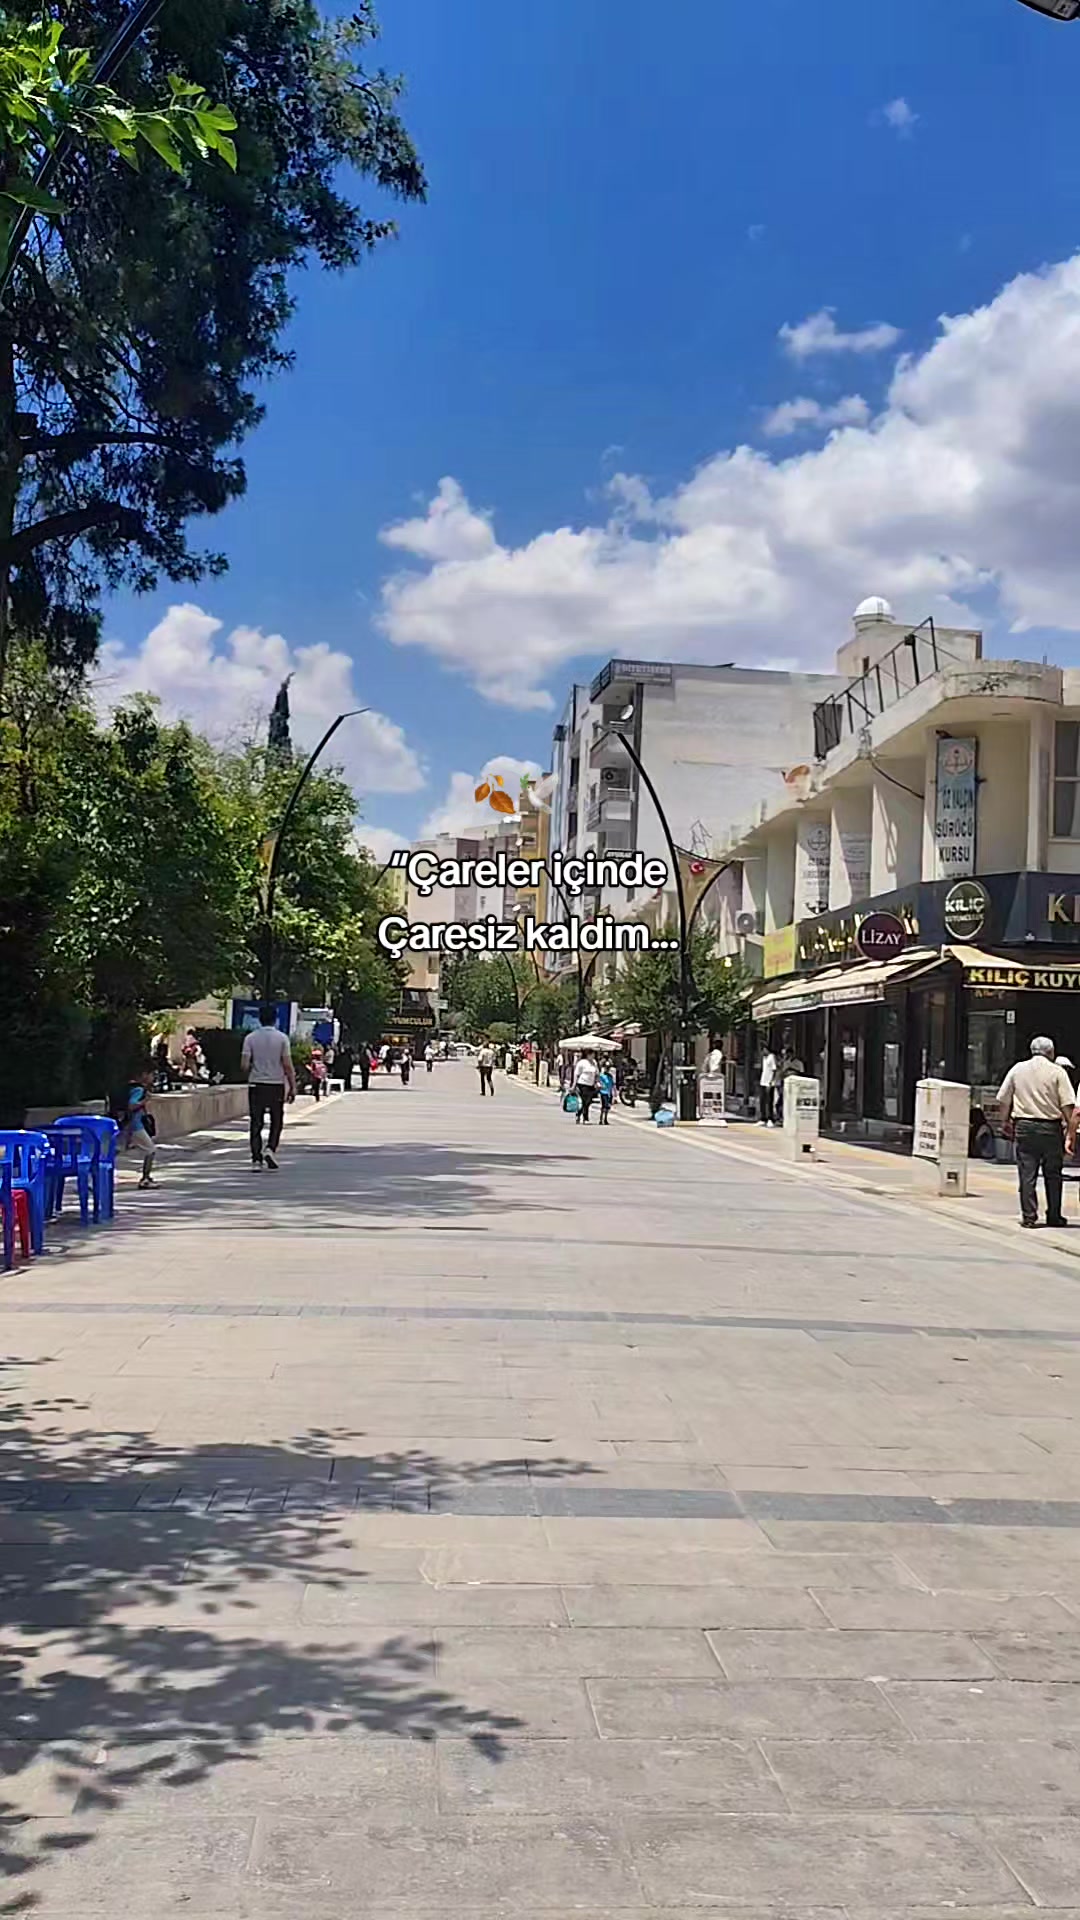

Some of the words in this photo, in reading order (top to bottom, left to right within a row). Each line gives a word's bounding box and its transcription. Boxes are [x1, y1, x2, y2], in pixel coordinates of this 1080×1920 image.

[936, 818, 973, 837] SÜRÜCÜ
[939, 847, 970, 863] KURSU
[945, 897, 985, 913] KILIÇ
[969, 969, 1030, 987] KILIÇ
[1034, 972, 1080, 988] KUY
